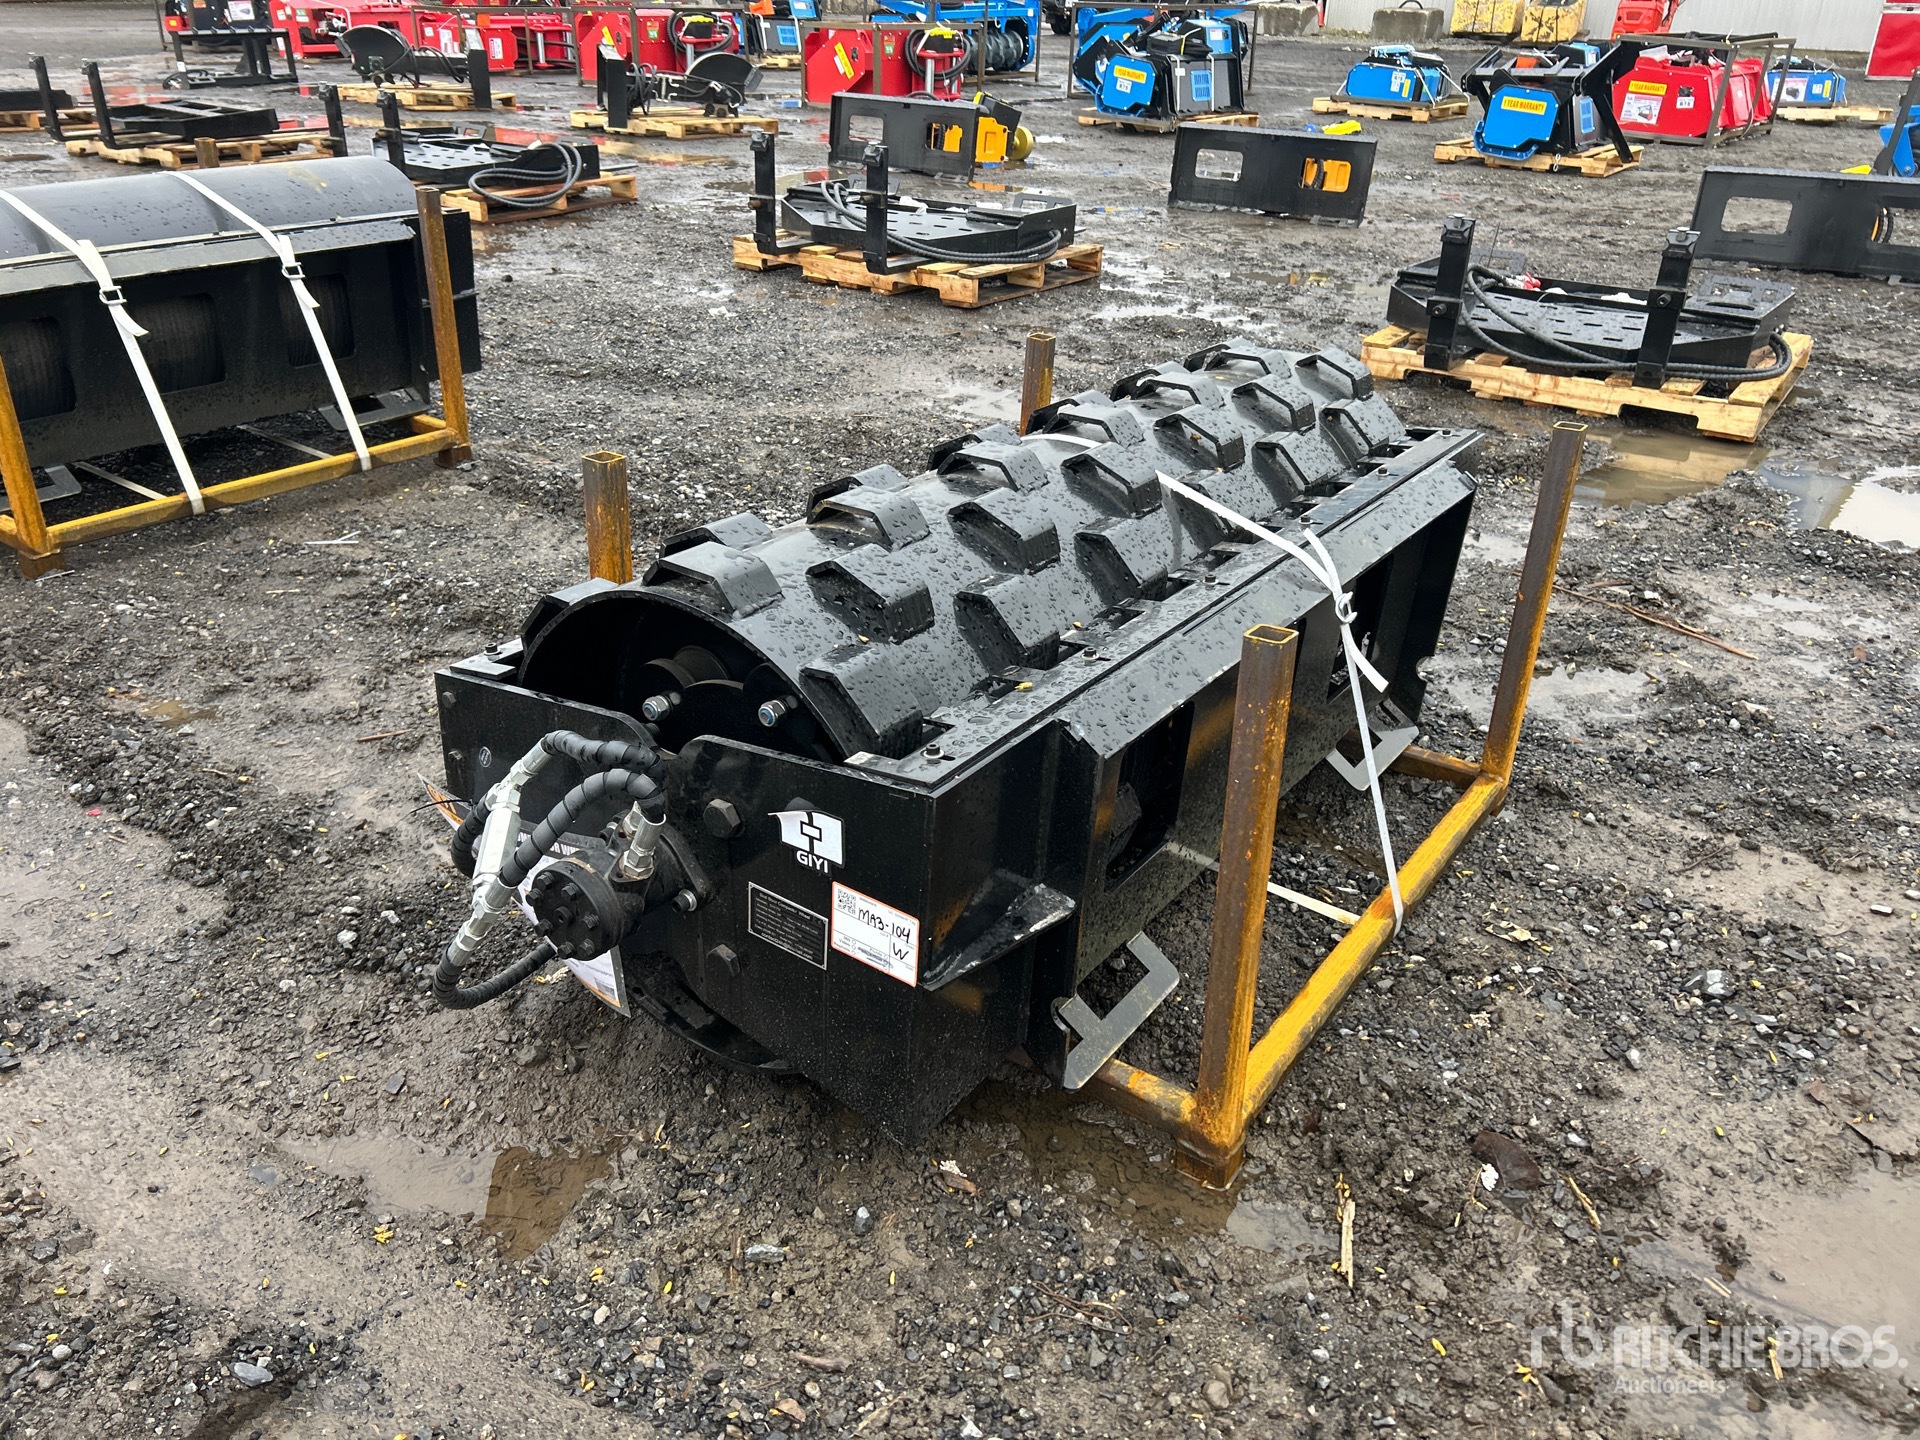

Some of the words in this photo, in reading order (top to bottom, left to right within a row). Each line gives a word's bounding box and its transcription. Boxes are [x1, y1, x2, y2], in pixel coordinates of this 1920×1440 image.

[1507, 99, 1519, 108] YEAR
[1519, 101, 1544, 112] WARRANTY
[796, 851, 828, 873] GIYI
[858, 907, 911, 943] MA3-104
[892, 942, 909, 961] W
